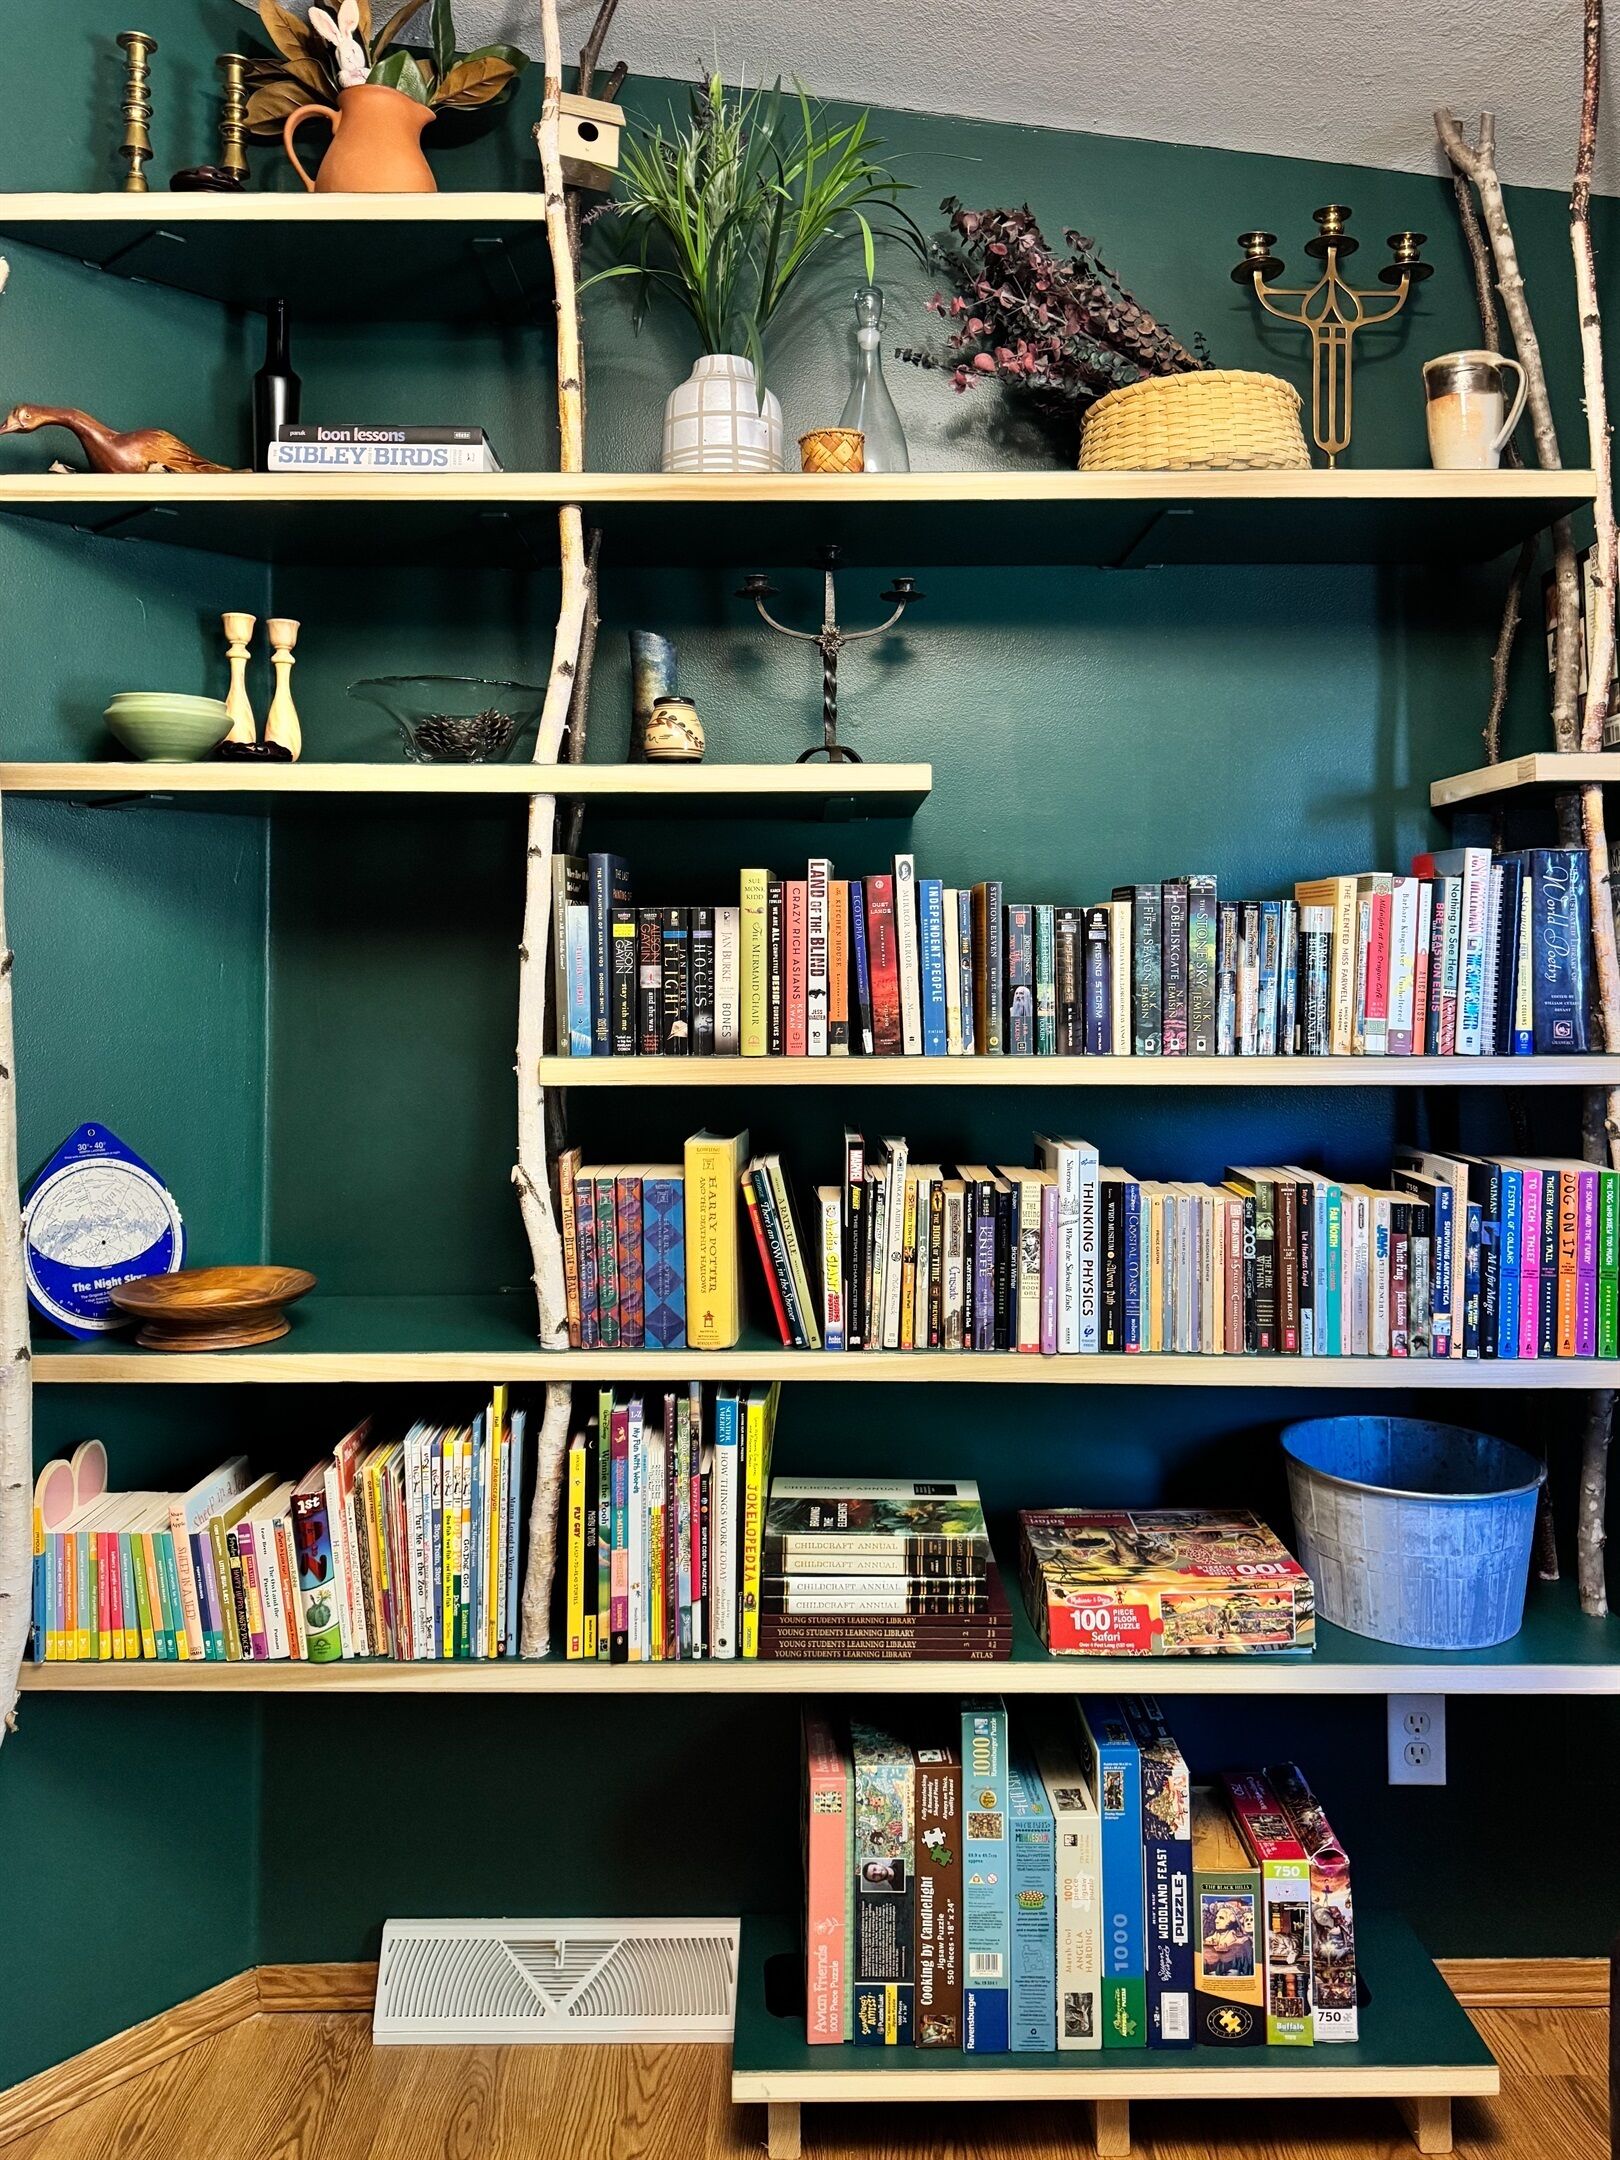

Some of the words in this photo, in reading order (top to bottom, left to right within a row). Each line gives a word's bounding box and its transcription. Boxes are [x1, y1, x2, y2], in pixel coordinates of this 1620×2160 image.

[318, 427, 350, 441] loon
[354, 427, 405, 442] lessons
[279, 446, 367, 464] SIBLEY
[374, 448, 448, 466] BIRDS
[811, 862, 825, 898] LAND
[792, 888, 800, 924] CRAZY
[811, 901, 822, 912] OF
[1402, 894, 1410, 922] Barbara
[1448, 883, 1460, 922] Nothing
[1543, 867, 1569, 927] World
[810, 914, 822, 934] THE
[853, 896, 863, 939] ECOTOPIA
[929, 886, 941, 959] INDEPENDENT
[1144, 907, 1154, 937] FIFTH
[1170, 905, 1180, 950] OBELISK
[1450, 927, 1457, 937] to
[792, 929, 800, 956] RICH
[1197, 914, 1209, 958] STONE
[1400, 925, 1410, 966] Kingsolver
[1449, 939, 1457, 956] See
[810, 938, 825, 977] BLIND
[1144, 939, 1154, 981] SEASON
[1170, 952, 1179, 984] GATE
[1448, 959, 1457, 981] Here
[1544, 928, 1570, 983] Poetry
[664, 944, 678, 1016] FLIGHT
[694, 945, 707, 1008] HOCUS
[792, 959, 800, 999] ASIANS
[932, 962, 942, 1002] PEOPLE
[1197, 961, 1208, 987] SKY
[1340, 968, 1350, 1003] FARWELL
[722, 1003, 731, 1038] BONES
[850, 1150, 863, 1182] MARVEL
[1529, 1178, 1537, 1189] TO
[1564, 1174, 1575, 1206] DOG
[709, 1177, 717, 1230] HARRY
[1083, 1182, 1094, 1252] THINKING
[1508, 1186, 1516, 1218] FISTFUL
[1528, 1194, 1536, 1222] FETCH
[1507, 1221, 1514, 1230] OF
[1564, 1214, 1575, 1232] ON
[979, 1226, 988, 1277] KNIFE
[1244, 1226, 1256, 1260] 2001
[1377, 1225, 1388, 1258] JAWS
[1399, 1241, 1407, 1260] White
[1506, 1232, 1514, 1264] COLLARS
[1527, 1235, 1535, 1264] THIEF
[1563, 1240, 1575, 1258] IT
[709, 1238, 718, 1293] POTTER
[1393, 1262, 1407, 1280] Fang
[73, 1282, 91, 1292] The
[94, 1278, 121, 1290] Night
[1083, 1259, 1093, 1316] PHYSICS
[602, 1451, 610, 1483] Winnie
[721, 1452, 729, 1476] HOW
[297, 1497, 320, 1514] 1st
[721, 1479, 729, 1515] THINGS
[720, 1516, 728, 1546] WORK
[810, 1506, 820, 1527] BRAVING
[824, 1517, 833, 1526] THE
[837, 1504, 848, 1528] ELEMENTS
[416, 1532, 423, 1544] Me
[746, 1484, 758, 1582] JOKELOPEDIA
[795, 1542, 853, 1550] CHILDCRAFT
[417, 1548, 422, 1558] in
[794, 1560, 853, 1568] CHILDCRAFT
[1236, 1564, 1290, 1575] 100
[797, 1583, 855, 1591] CHILDCRAFT
[1070, 1609, 1110, 1630] 100
[1092, 1631, 1120, 1641] Safari
[775, 1650, 802, 1658] YOUNG
[971, 1651, 993, 1659] ATLAS
[974, 1737, 990, 1776] 1000
[1157, 1848, 1167, 1879] FEAST
[1274, 1866, 1300, 1876] 750
[920, 1876, 934, 1940] Candlelight
[1158, 1884, 1168, 1939] WOODLAND
[1174, 1878, 1184, 1937] PUZZLE
[920, 1944, 934, 1957] by
[937, 1942, 946, 1970] Jigsaw
[1115, 1913, 1128, 1972] 1000
[814, 1944, 828, 1993] Friends
[830, 1960, 838, 1988] Puzzle
[920, 1960, 934, 2006] Cooking
[814, 1994, 827, 2033] Avian
[830, 1990, 838, 2012] Piece
[830, 2012, 838, 2032] 1000
[967, 1992, 976, 2049] Ravensburger
[1277, 2023, 1304, 2031] Buffalo
[1318, 2012, 1341, 2022] 750
